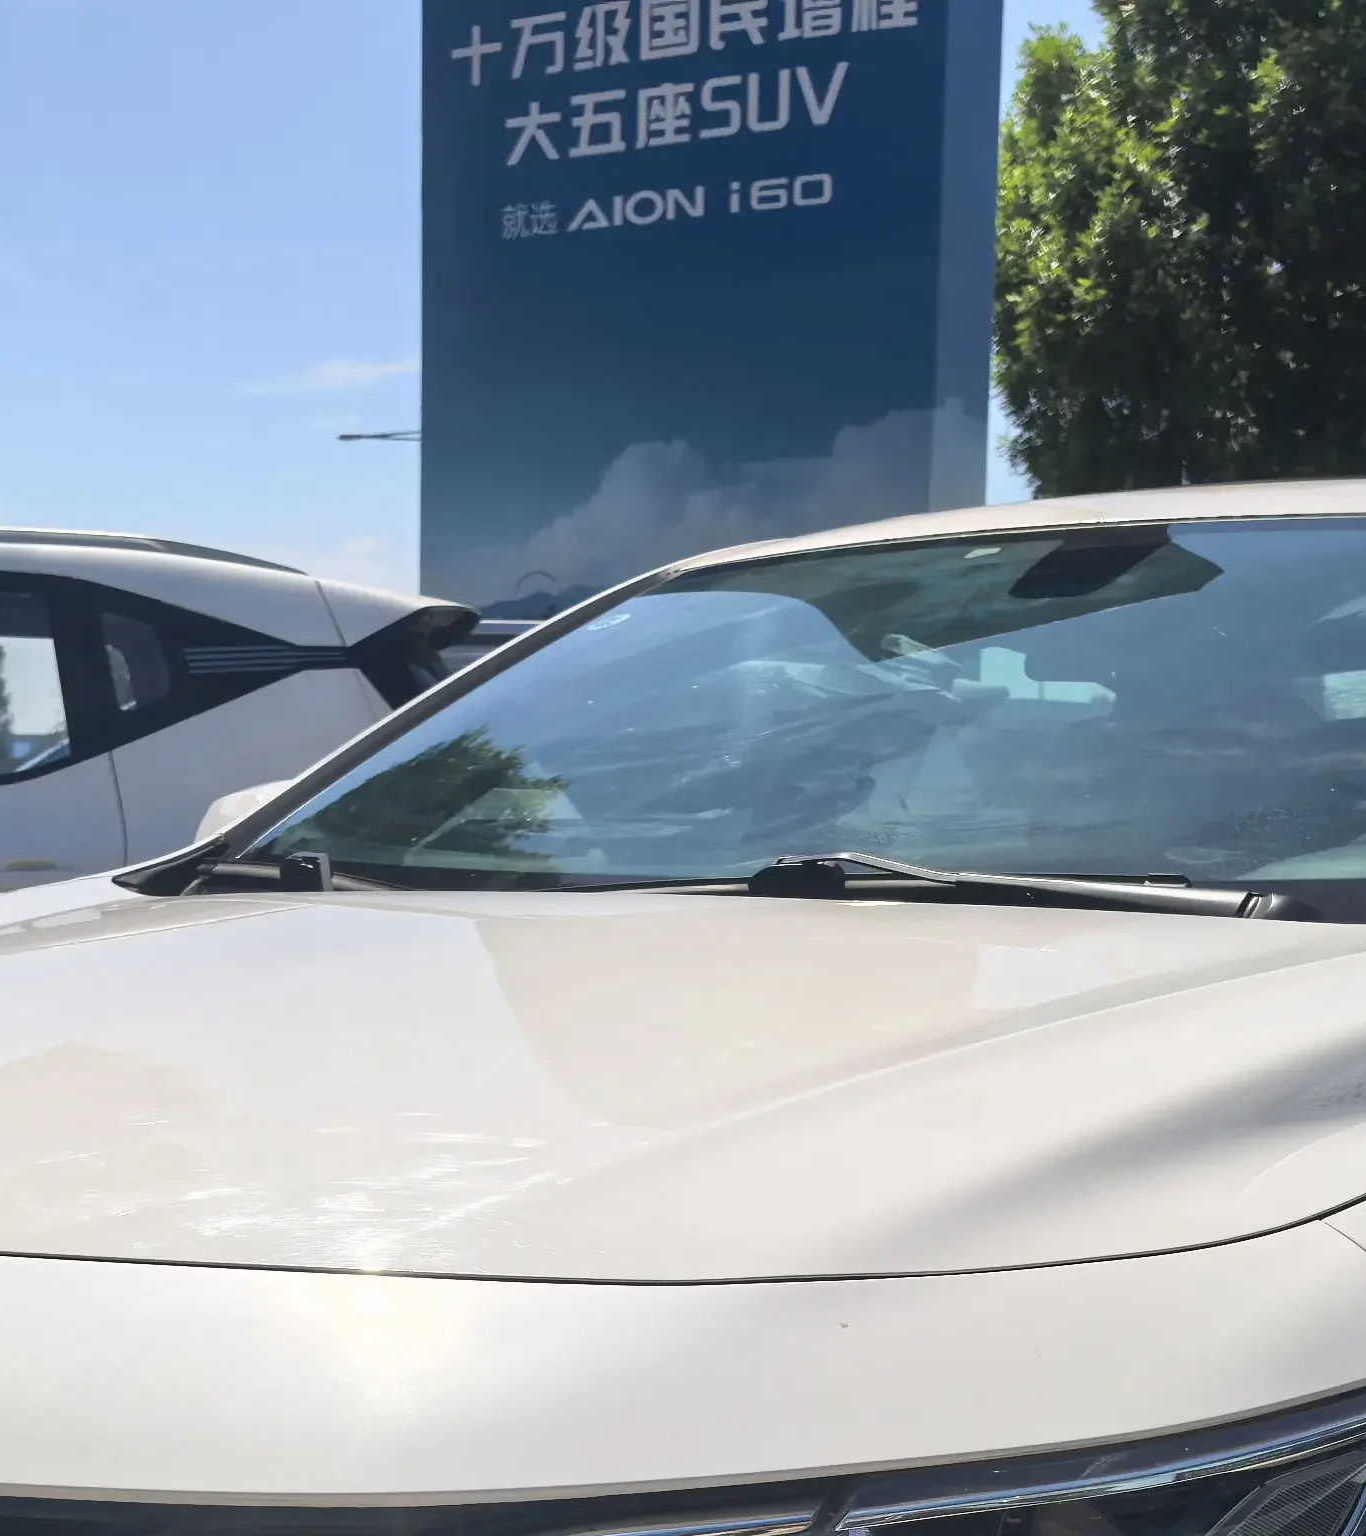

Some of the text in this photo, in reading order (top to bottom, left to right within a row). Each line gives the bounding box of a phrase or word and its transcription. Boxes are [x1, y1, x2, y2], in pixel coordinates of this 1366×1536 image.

[504, 61, 850, 167] 大五座SUV
[500, 172, 834, 241] 就选 AION i60
